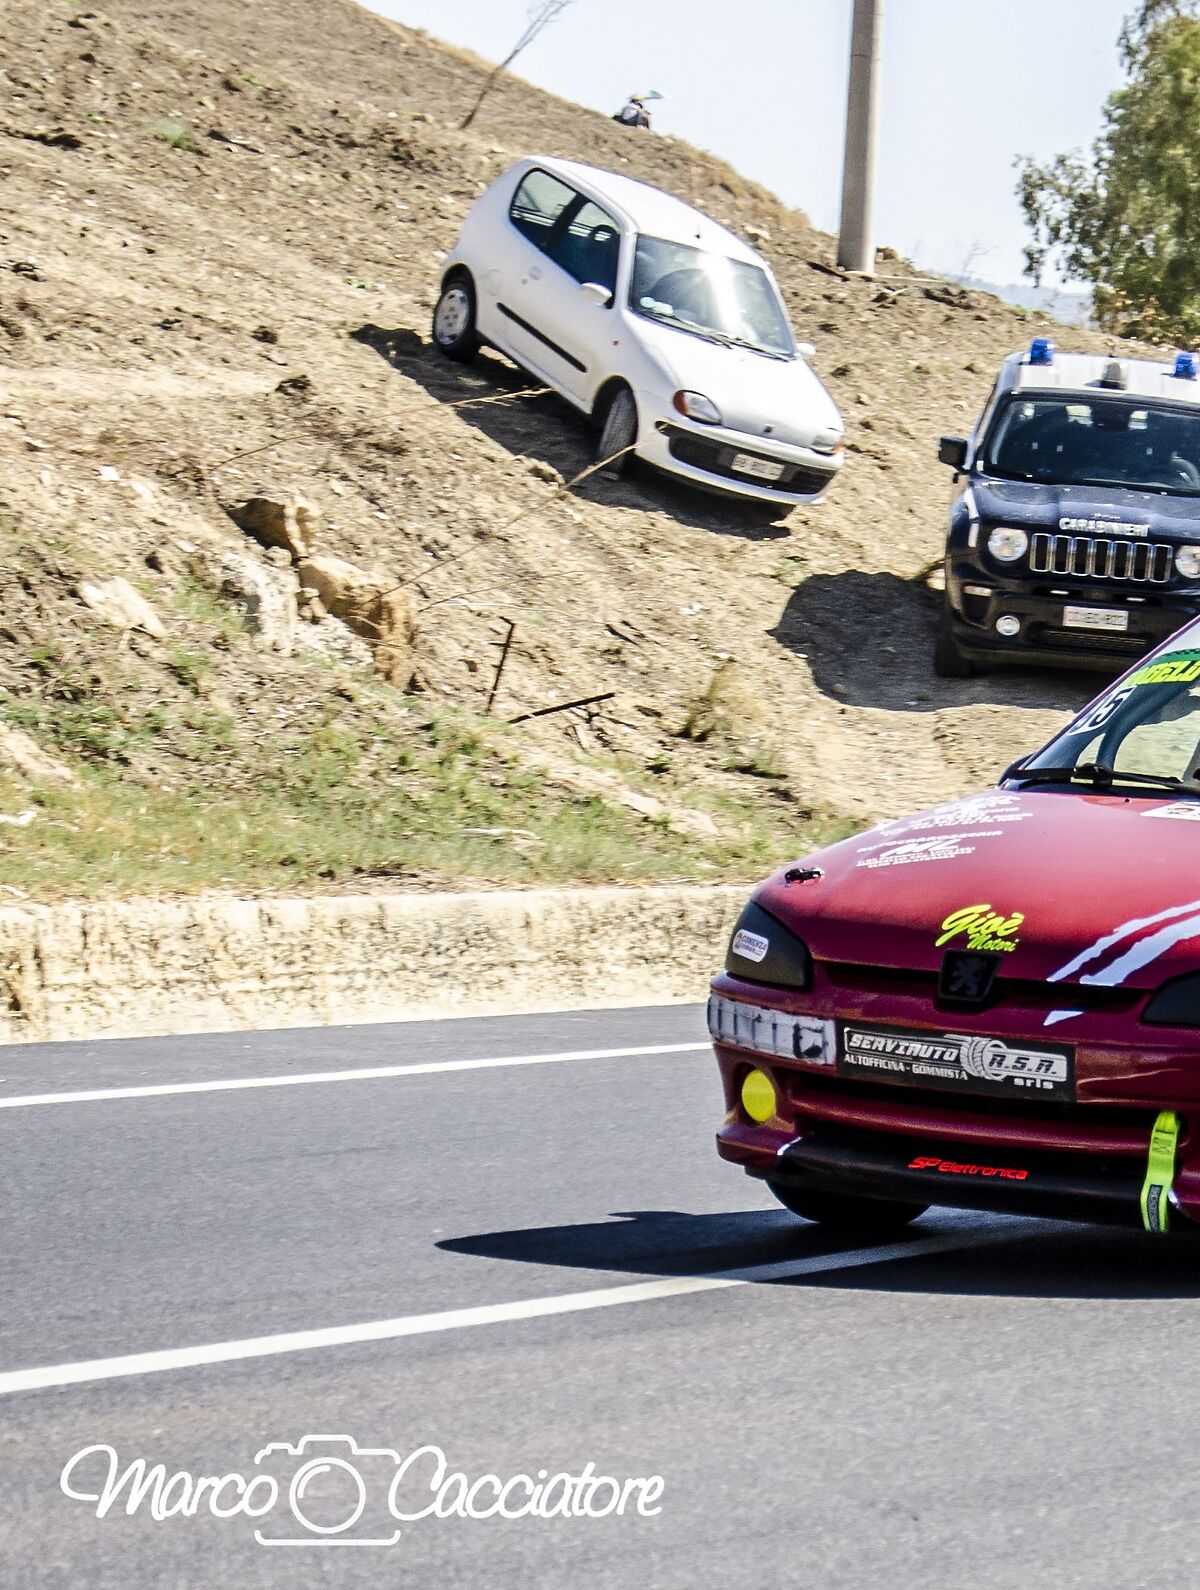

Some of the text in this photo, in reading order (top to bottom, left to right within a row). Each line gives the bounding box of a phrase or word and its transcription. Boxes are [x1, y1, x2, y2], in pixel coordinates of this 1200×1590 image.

[912, 1064, 969, 1081] GOMMISTA
[1013, 1078, 1054, 1090] srls
[907, 1156, 1028, 1180] SP Elettronica
